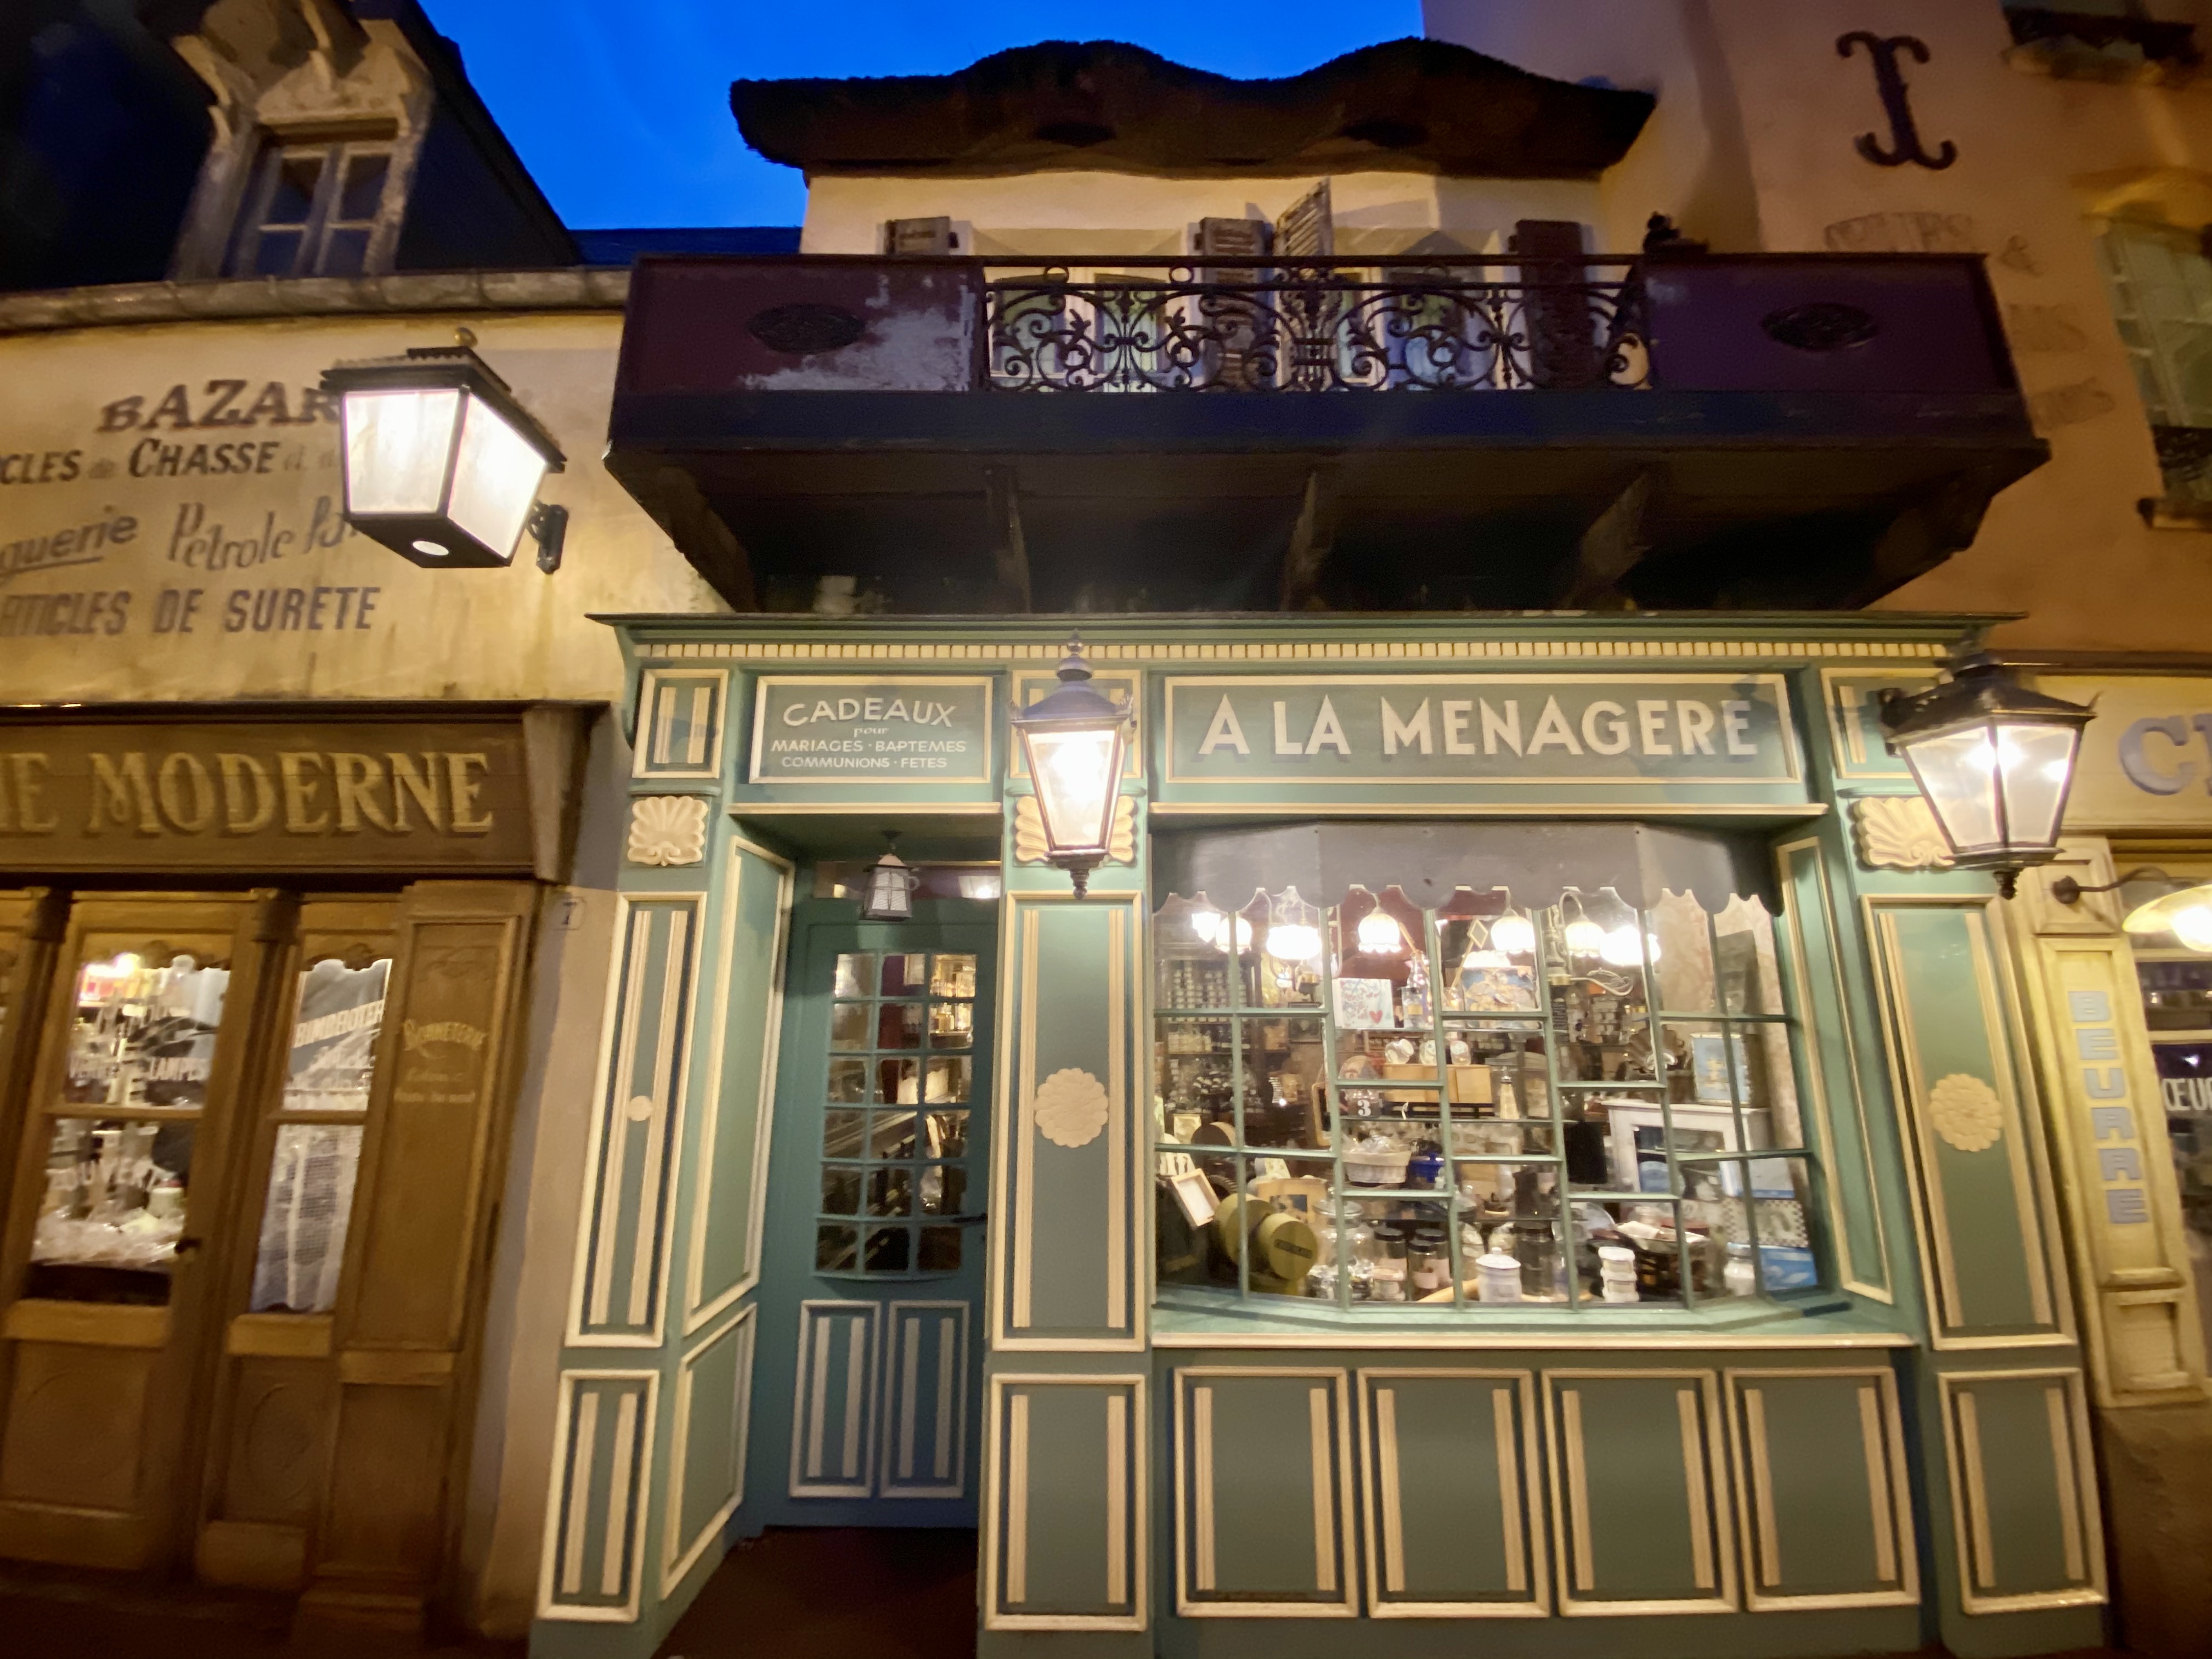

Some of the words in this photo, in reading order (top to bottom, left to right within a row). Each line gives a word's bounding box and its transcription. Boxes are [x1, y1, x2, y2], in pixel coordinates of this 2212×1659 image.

[128, 438, 280, 477] CHASSE
[154, 589, 204, 634] DE
[224, 586, 381, 633] SURETE
[783, 697, 956, 727] CADEAUX
[1198, 693, 1250, 756] A
[1273, 693, 1352, 756] LA
[1381, 693, 1759, 758] MENAGERE
[771, 740, 863, 752] MARIAGES
[875, 740, 967, 753] BAPTEMES
[854, 727, 889, 738] pour
[781, 757, 890, 769] COMMUNIONS
[901, 757, 948, 769] FETES
[86, 751, 493, 833] MODERNE
[1357, 1099, 1372, 1116] 3
[2067, 991, 2148, 1224] BEURRE
